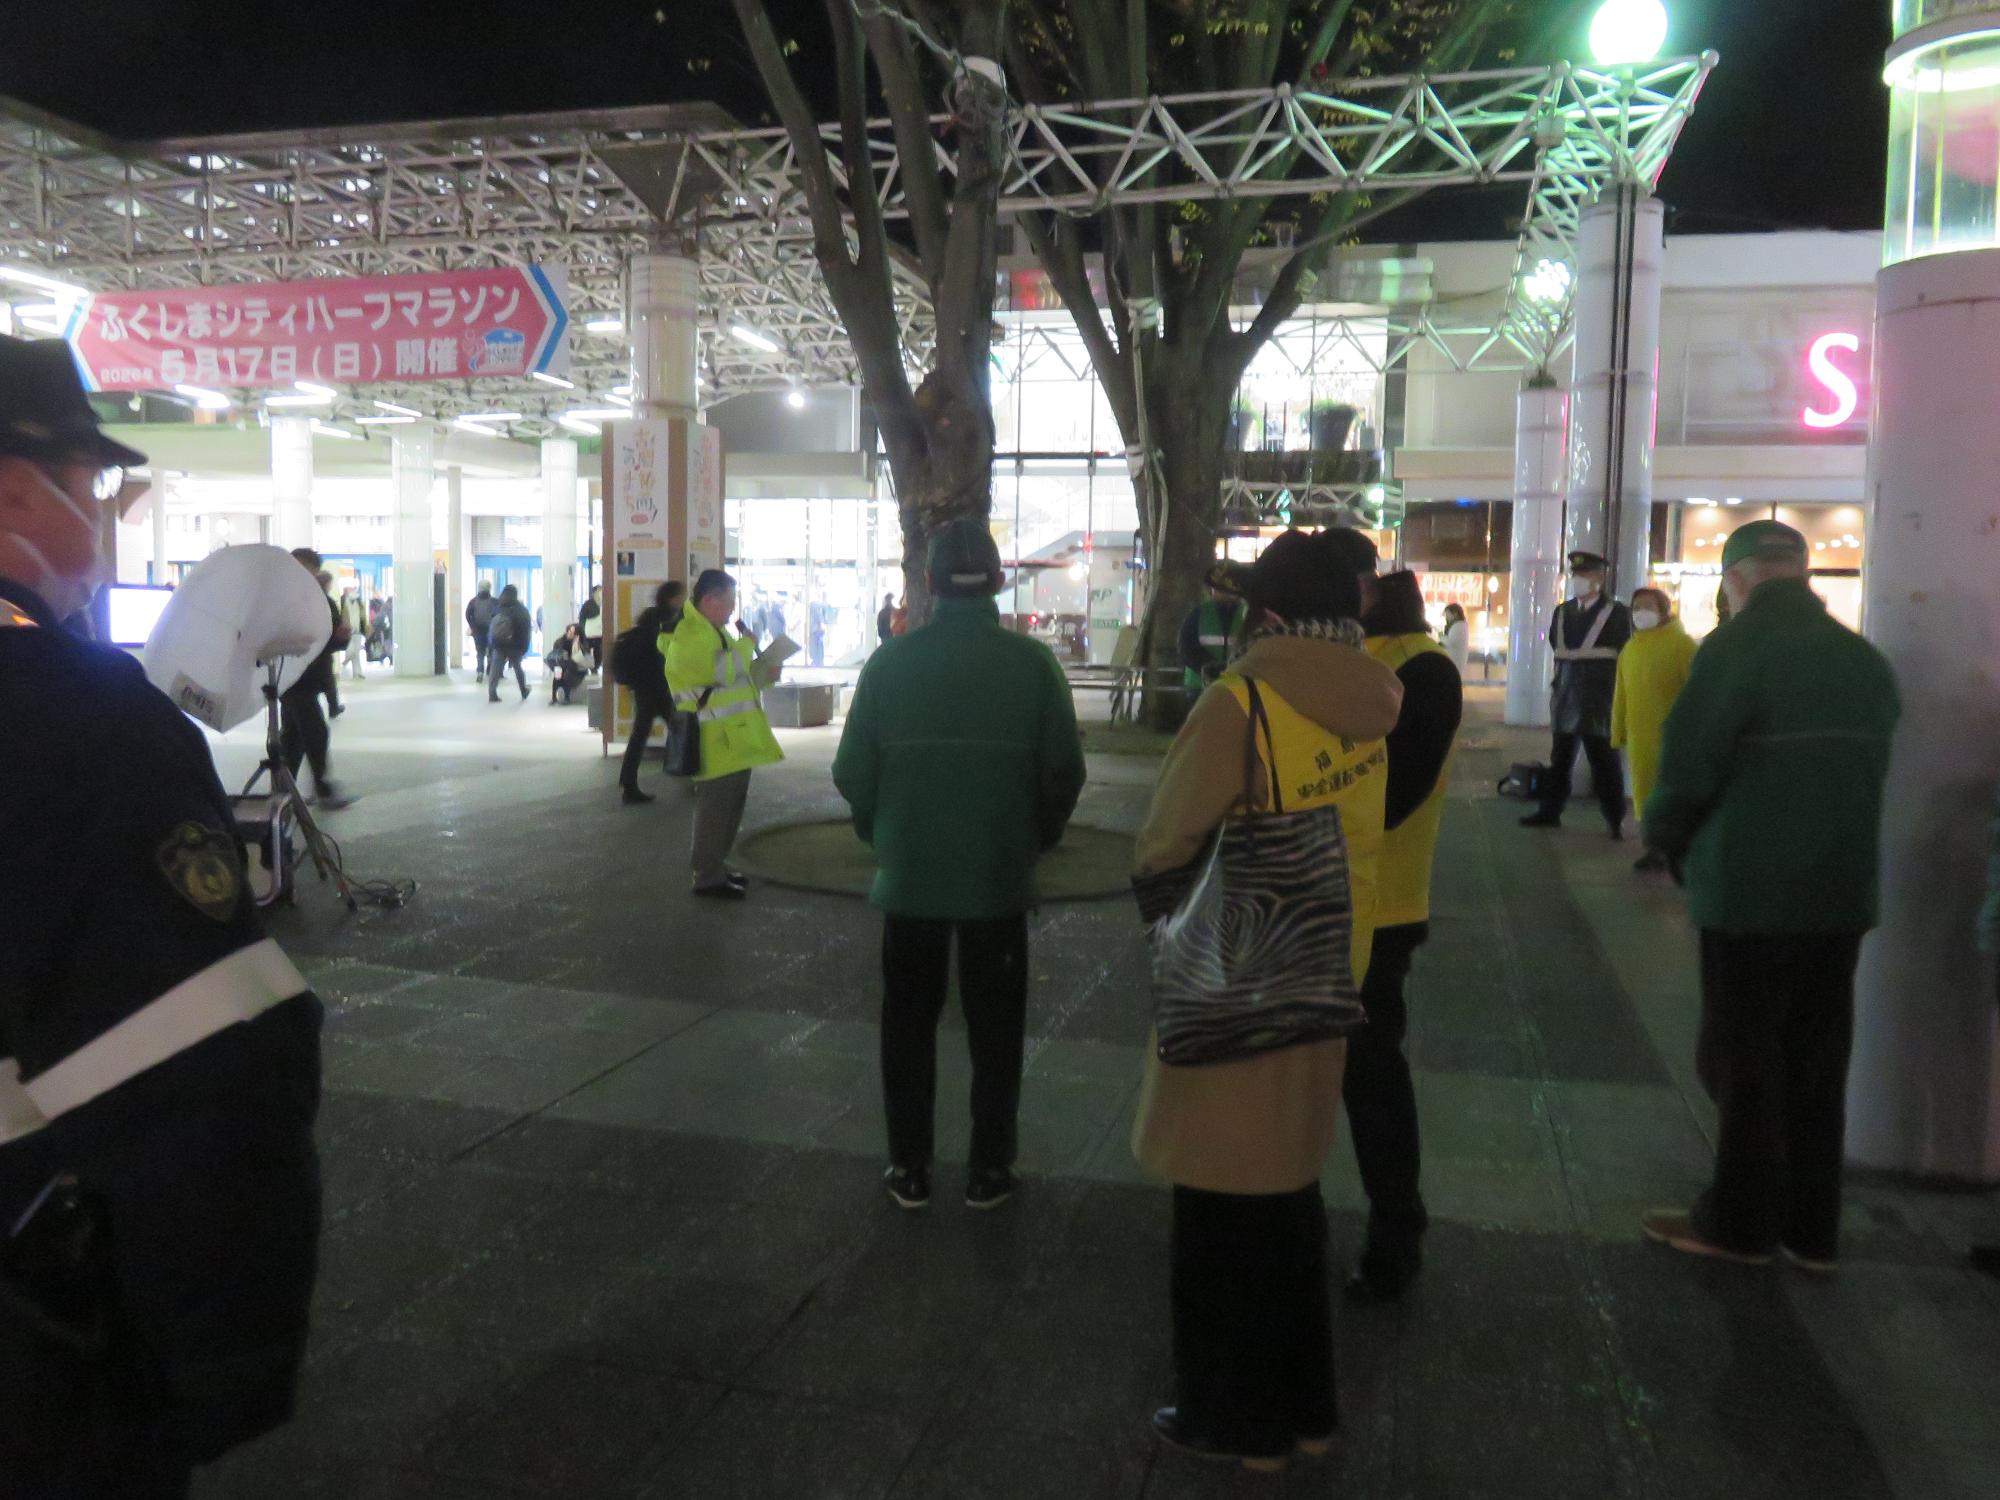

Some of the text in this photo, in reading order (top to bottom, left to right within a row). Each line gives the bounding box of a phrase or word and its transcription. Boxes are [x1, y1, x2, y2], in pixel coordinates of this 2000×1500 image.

[100, 286, 520, 343] ふくしまシティハーフマラソン
[1804, 332, 1859, 428] S
